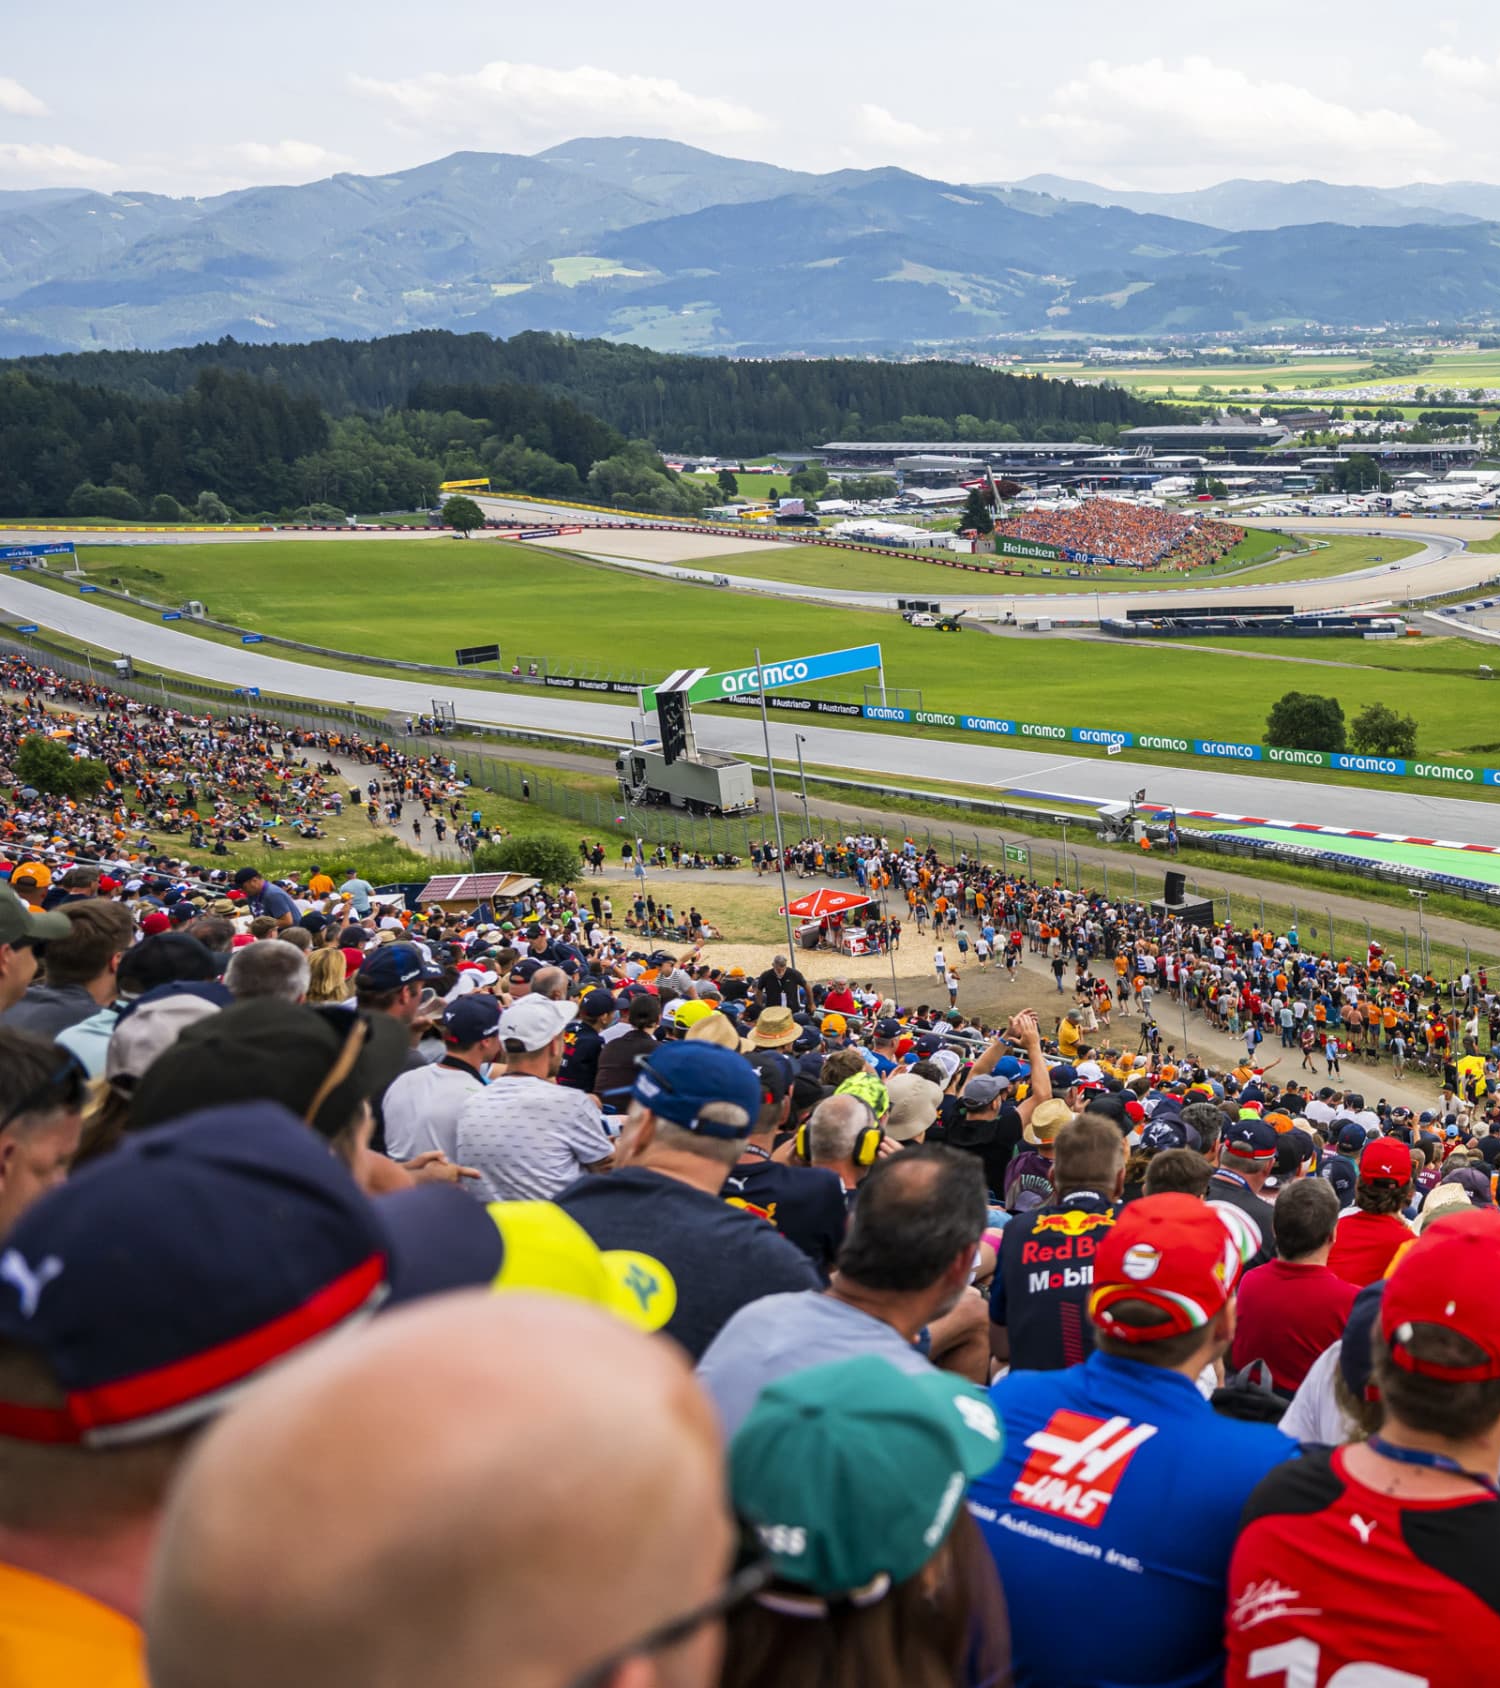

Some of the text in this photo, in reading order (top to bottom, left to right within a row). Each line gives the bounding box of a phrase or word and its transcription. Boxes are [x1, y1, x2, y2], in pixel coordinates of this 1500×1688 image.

[1003, 543, 1055, 558] Heineken
[722, 662, 808, 693] aramco
[867, 707, 904, 721] aramco
[916, 711, 956, 726] aramco
[967, 717, 1008, 732] aramco
[1022, 723, 1066, 739] aramco
[1080, 730, 1125, 745] aramco
[1140, 736, 1188, 751] aramco
[1202, 741, 1253, 758] aramco
[1269, 748, 1322, 766] aramco
[1340, 755, 1396, 772] aramco
[1414, 763, 1474, 781] aramco
[1022, 1238, 1072, 1264] Red
[1028, 1266, 1093, 1294] Mobil
[1013, 1474, 1113, 1520] HAAS
[997, 1512, 1102, 1560] Automation
